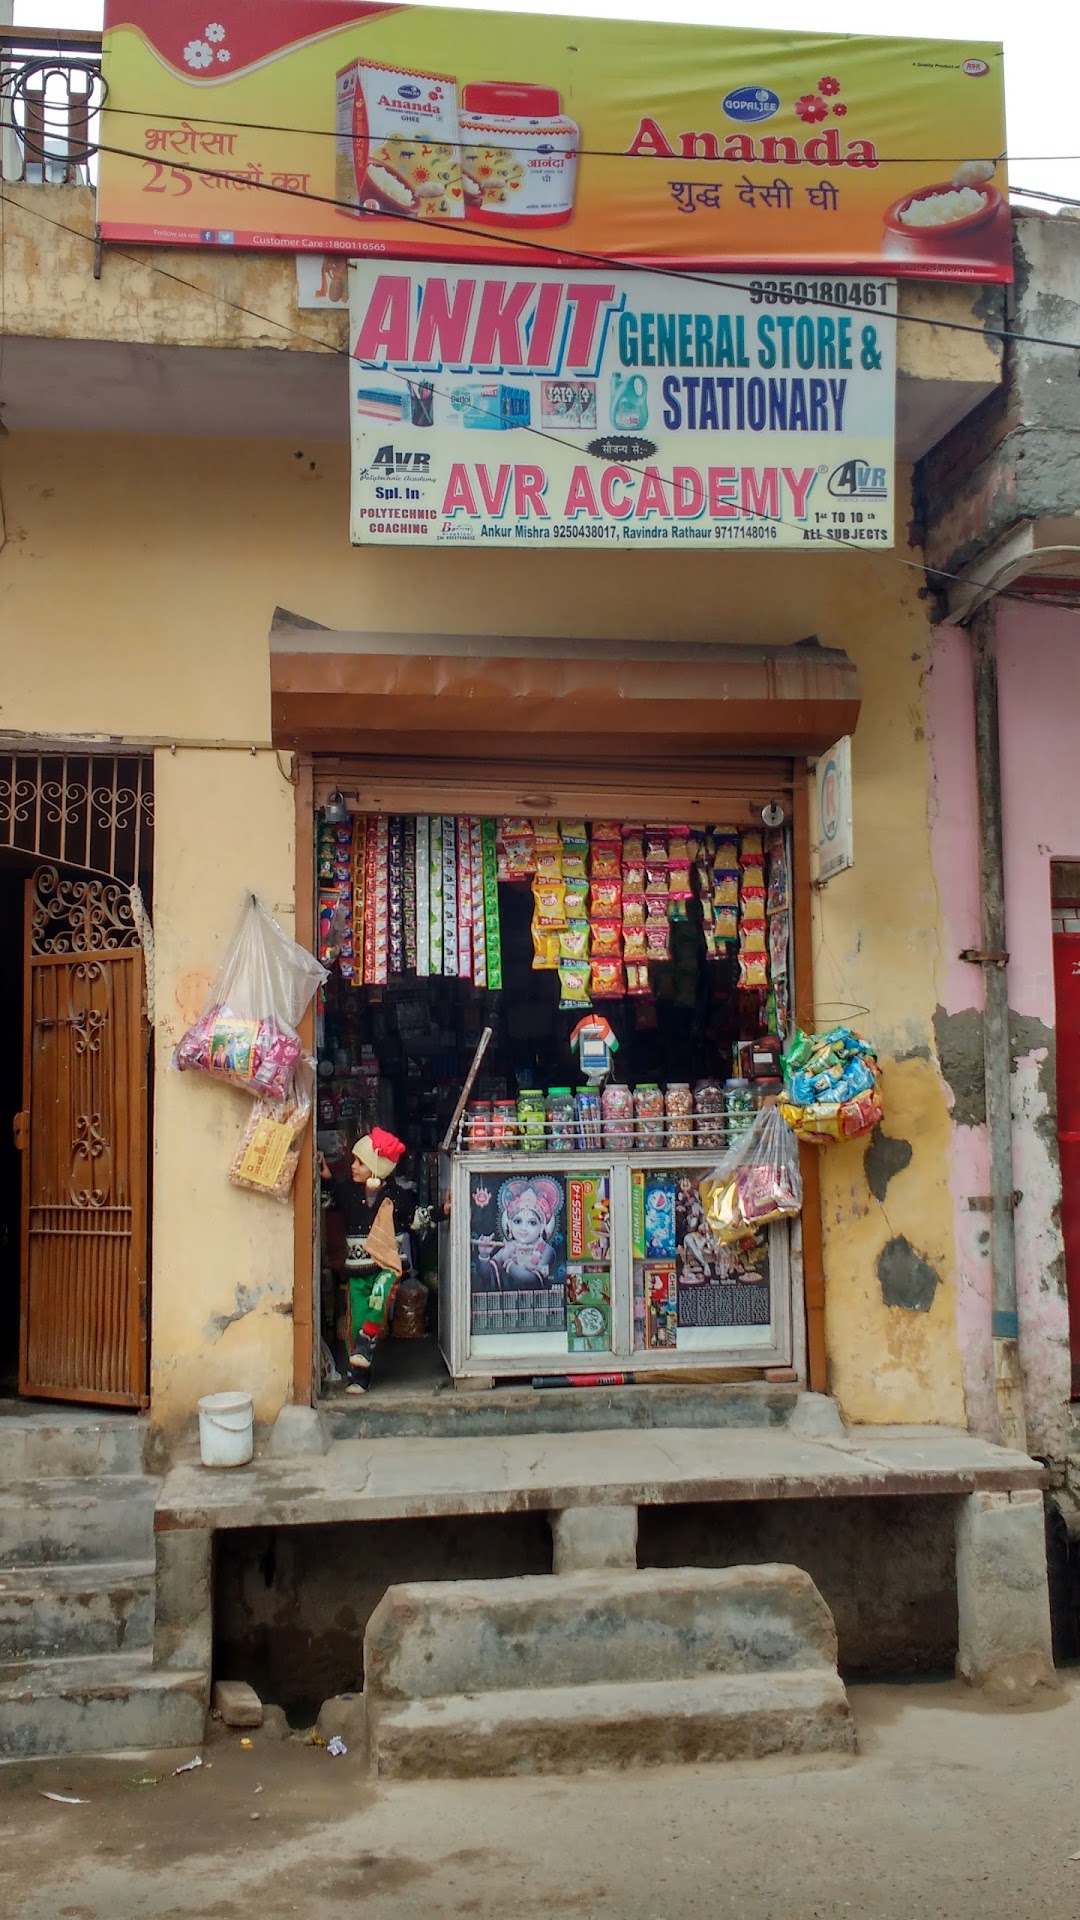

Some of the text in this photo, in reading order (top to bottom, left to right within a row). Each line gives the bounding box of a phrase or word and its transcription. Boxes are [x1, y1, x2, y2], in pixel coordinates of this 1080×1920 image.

[377, 94, 441, 114] Ananda
[724, 100, 778, 112] GOPALJEE
[144, 122, 238, 155] भरोसा
[624, 117, 880, 168] Ananda
[142, 161, 311, 196] 25 सालों का
[668, 175, 840, 214] शुद्ध देसी घी
[153, 228, 177, 238] Follow
[253, 236, 299, 246] Customer
[302, 238, 323, 248] Care
[354, 275, 622, 374] ANKIT
[618, 312, 882, 372] GENERAL STORE &
[550, 387, 573, 396] TATA
[550, 394, 573, 403] SALT
[663, 376, 847, 432] STATIONARY
[601, 442, 628, 454] सौजन्य
[371, 445, 431, 474] AVR
[837, 460, 886, 494] AVR
[376, 486, 420, 500] Spl. In
[442, 464, 549, 517] AVR
[564, 466, 816, 518] ACADEMY
[360, 508, 436, 520] POLYTECHNIC
[831, 512, 845, 523] TO
[850, 512, 863, 523] 10
[370, 523, 428, 534] COACHING
[480, 524, 512, 538] Ankur
[515, 525, 550, 538] Mishra
[623, 526, 668, 538] Ravindra
[672, 526, 712, 538] Rathaur
[714, 526, 776, 538] 9717148016
[803, 529, 888, 540] ALL SUBJECTS
